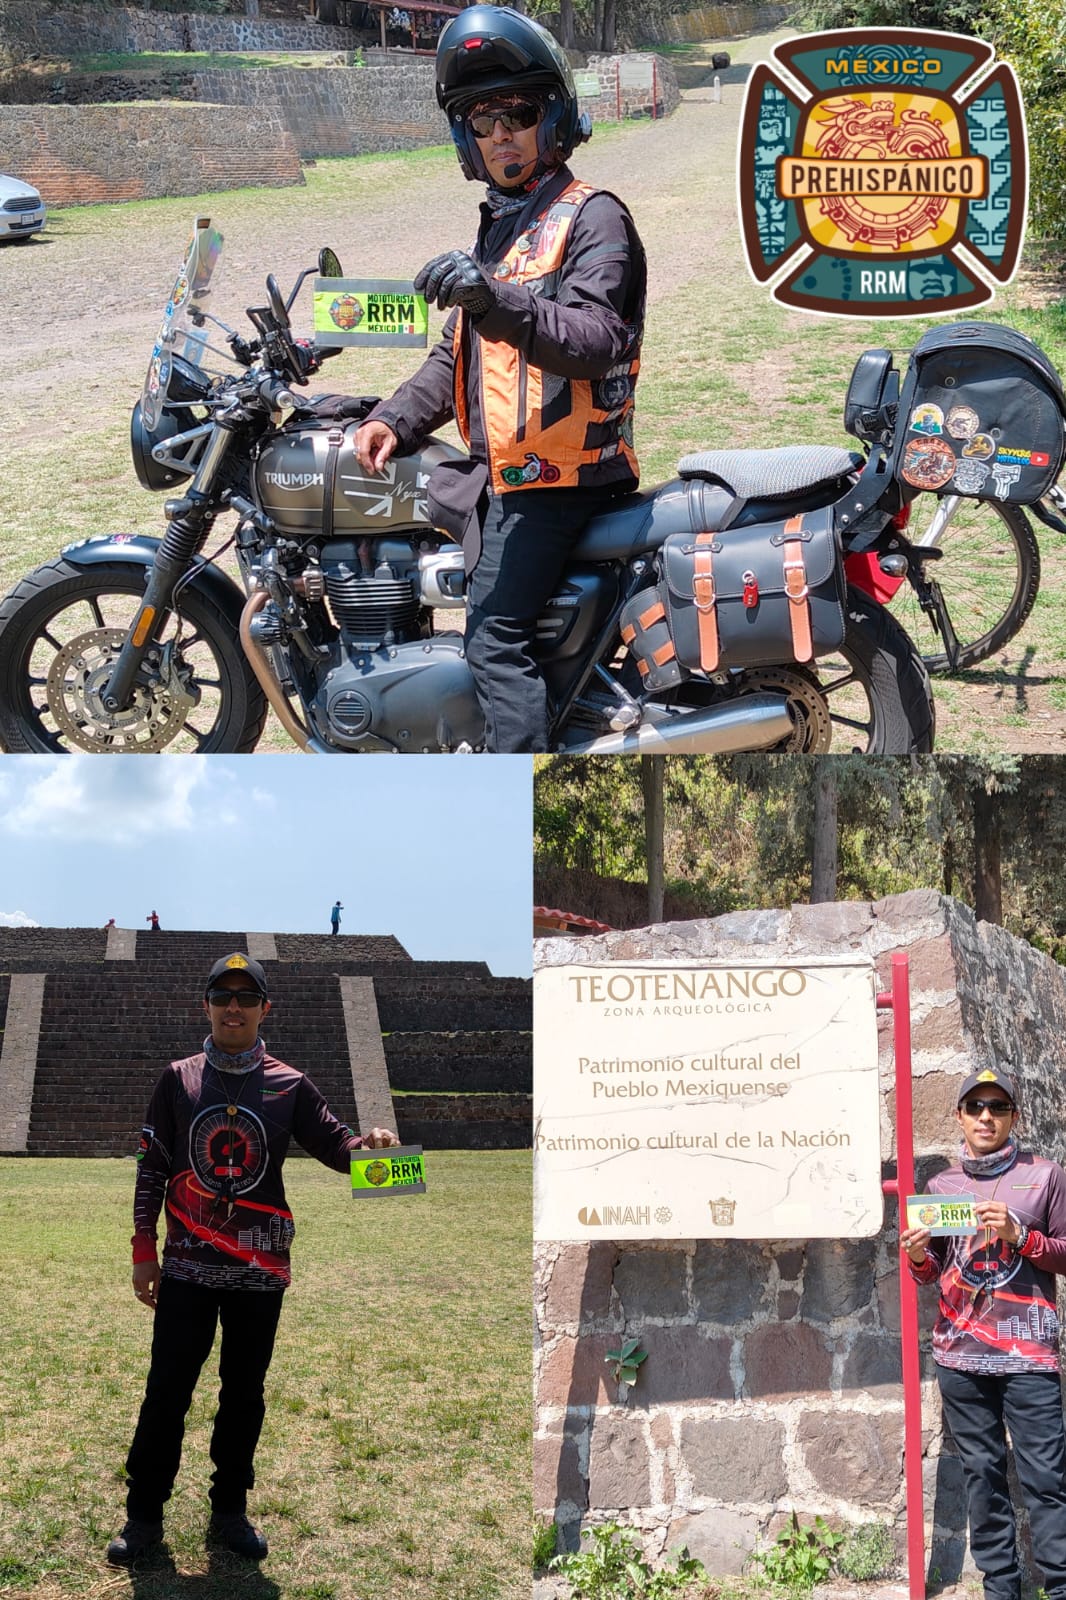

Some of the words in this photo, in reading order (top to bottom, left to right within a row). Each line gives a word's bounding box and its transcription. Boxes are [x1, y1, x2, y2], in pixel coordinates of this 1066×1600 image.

[367, 294, 415, 303] MOTOTURISTA
[367, 303, 415, 323] RRM
[264, 471, 325, 487] TRIUMPH
[569, 968, 807, 1003] TEOTENANGO
[603, 1007, 645, 1017] ZONA
[653, 1002, 772, 1017] ARQUEOLÓGICA
[578, 1055, 684, 1074] Patrimonio
[691, 1054, 763, 1071] cultural
[770, 1052, 801, 1070] del
[592, 1080, 659, 1098] Pueblo
[665, 1078, 789, 1101] Mexiquense
[535, 1133, 640, 1151] Patrimonio
[646, 1131, 719, 1149] cultural
[725, 1132, 751, 1148] de
[757, 1131, 775, 1147] la
[781, 1129, 851, 1148] Nación
[391, 1163, 422, 1178] RRM
[602, 1206, 650, 1226] INAH
[941, 1209, 971, 1220] RRM
